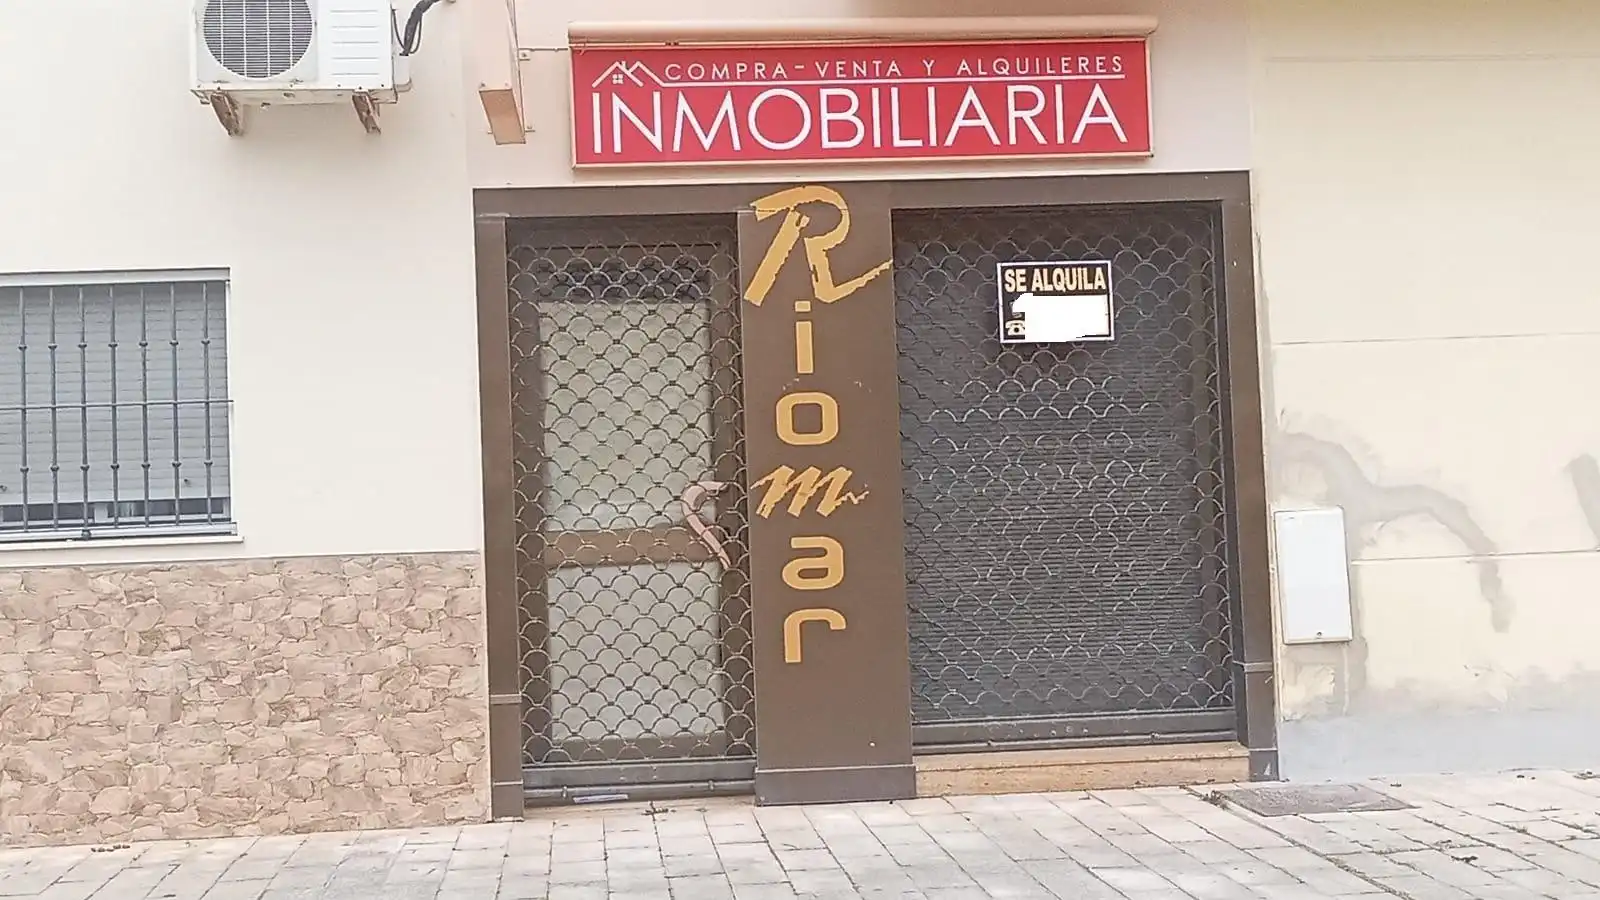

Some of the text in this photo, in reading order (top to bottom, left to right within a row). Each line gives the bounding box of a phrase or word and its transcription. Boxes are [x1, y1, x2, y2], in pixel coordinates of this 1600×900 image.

[923, 60, 935, 76] Y
[957, 56, 1123, 75] ALQUILERES
[591, 83, 1128, 154] INMOBILIARIA
[1004, 267, 1107, 292] SE ALQUILA
[743, 185, 894, 664] Riomar
